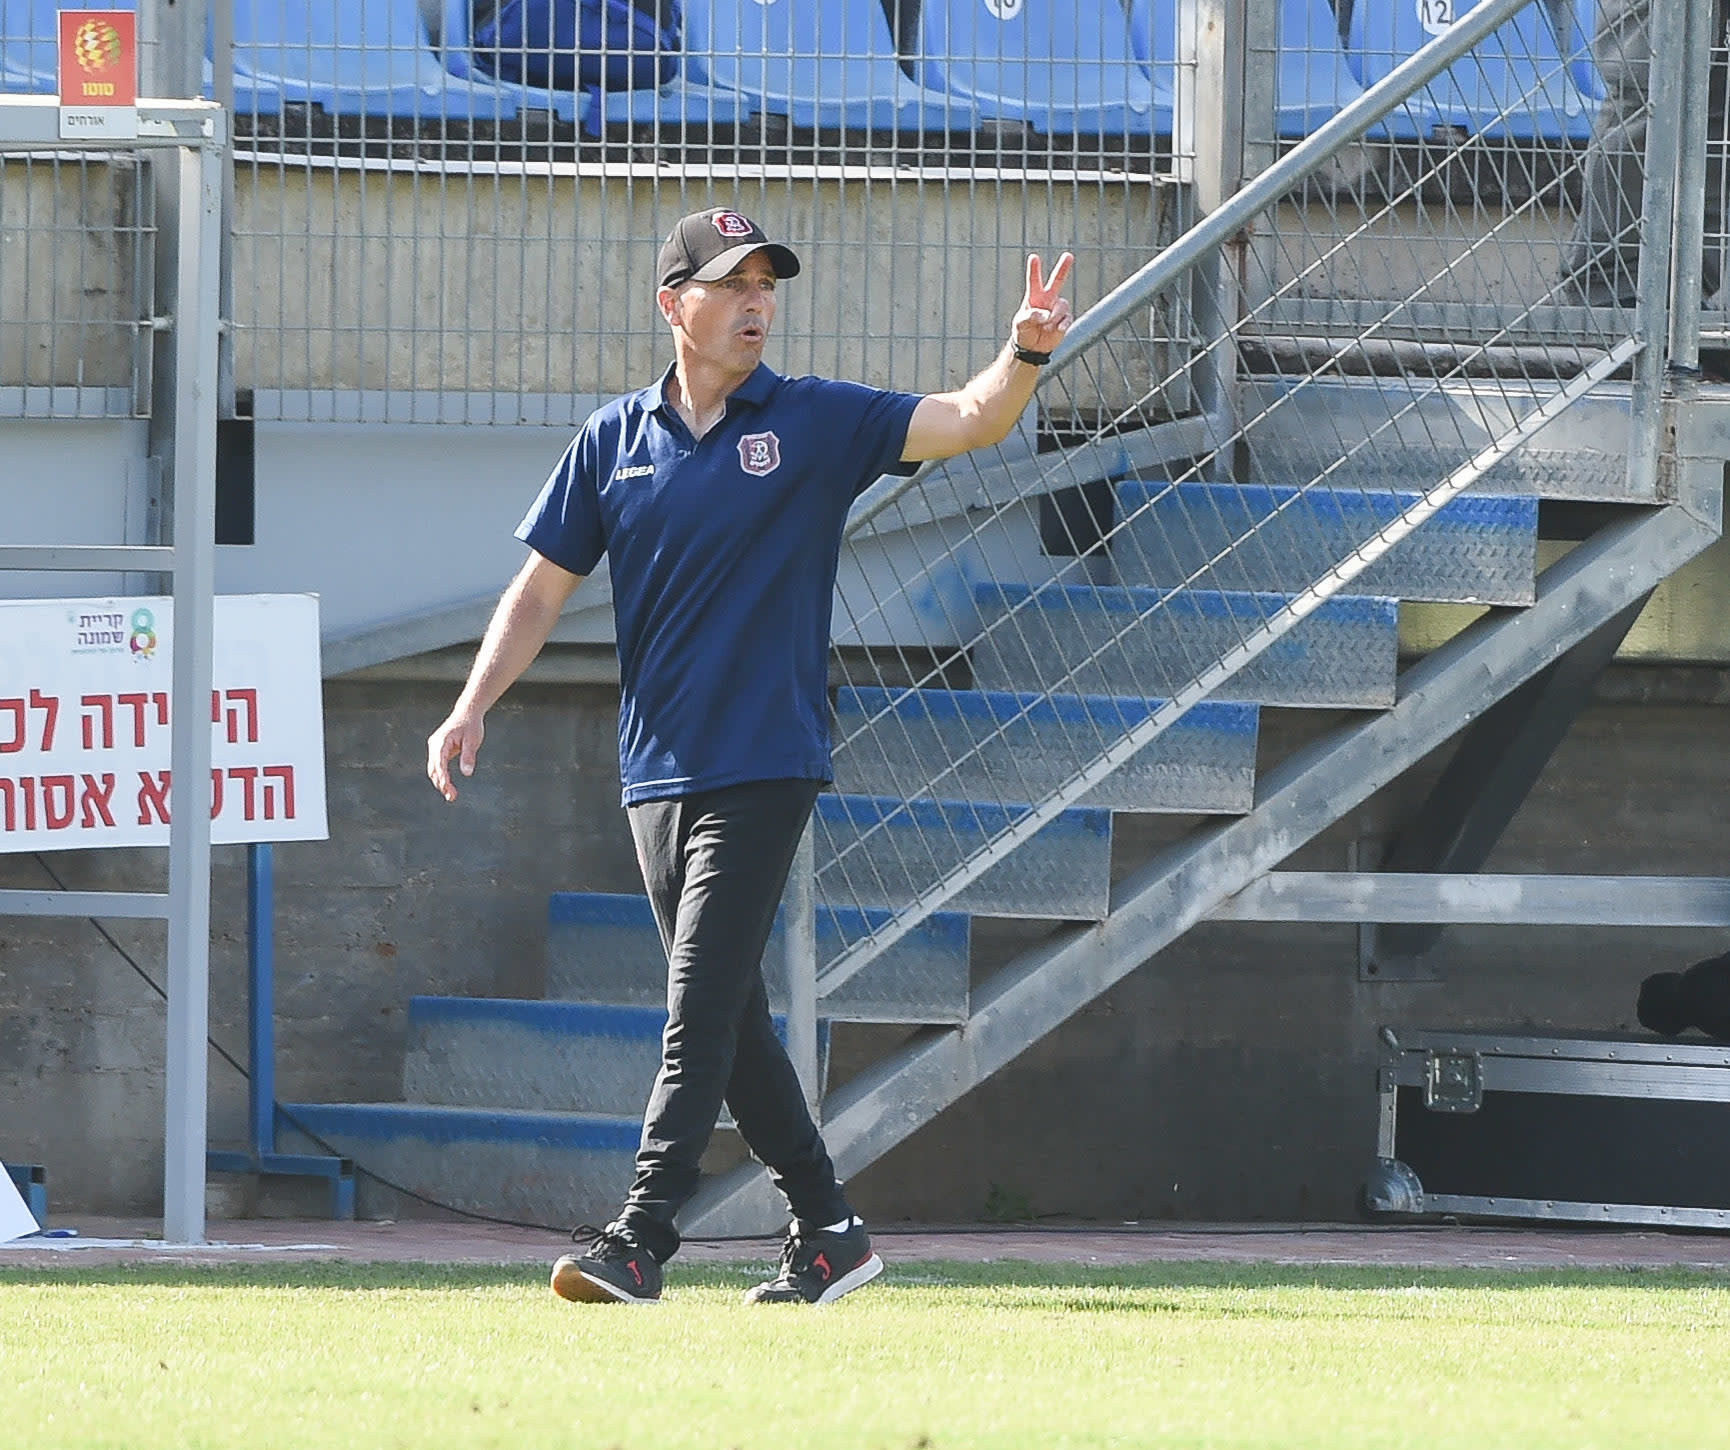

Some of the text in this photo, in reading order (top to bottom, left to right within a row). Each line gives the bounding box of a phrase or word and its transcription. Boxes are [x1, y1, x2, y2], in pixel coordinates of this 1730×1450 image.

[82, 82, 115, 96] טוטו
[67, 115, 105, 126] אורחים
[614, 464, 655, 481] LEGEA
[79, 614, 124, 629] קריית
[77, 631, 124, 645] שמונה
[81, 688, 259, 750] היידה
